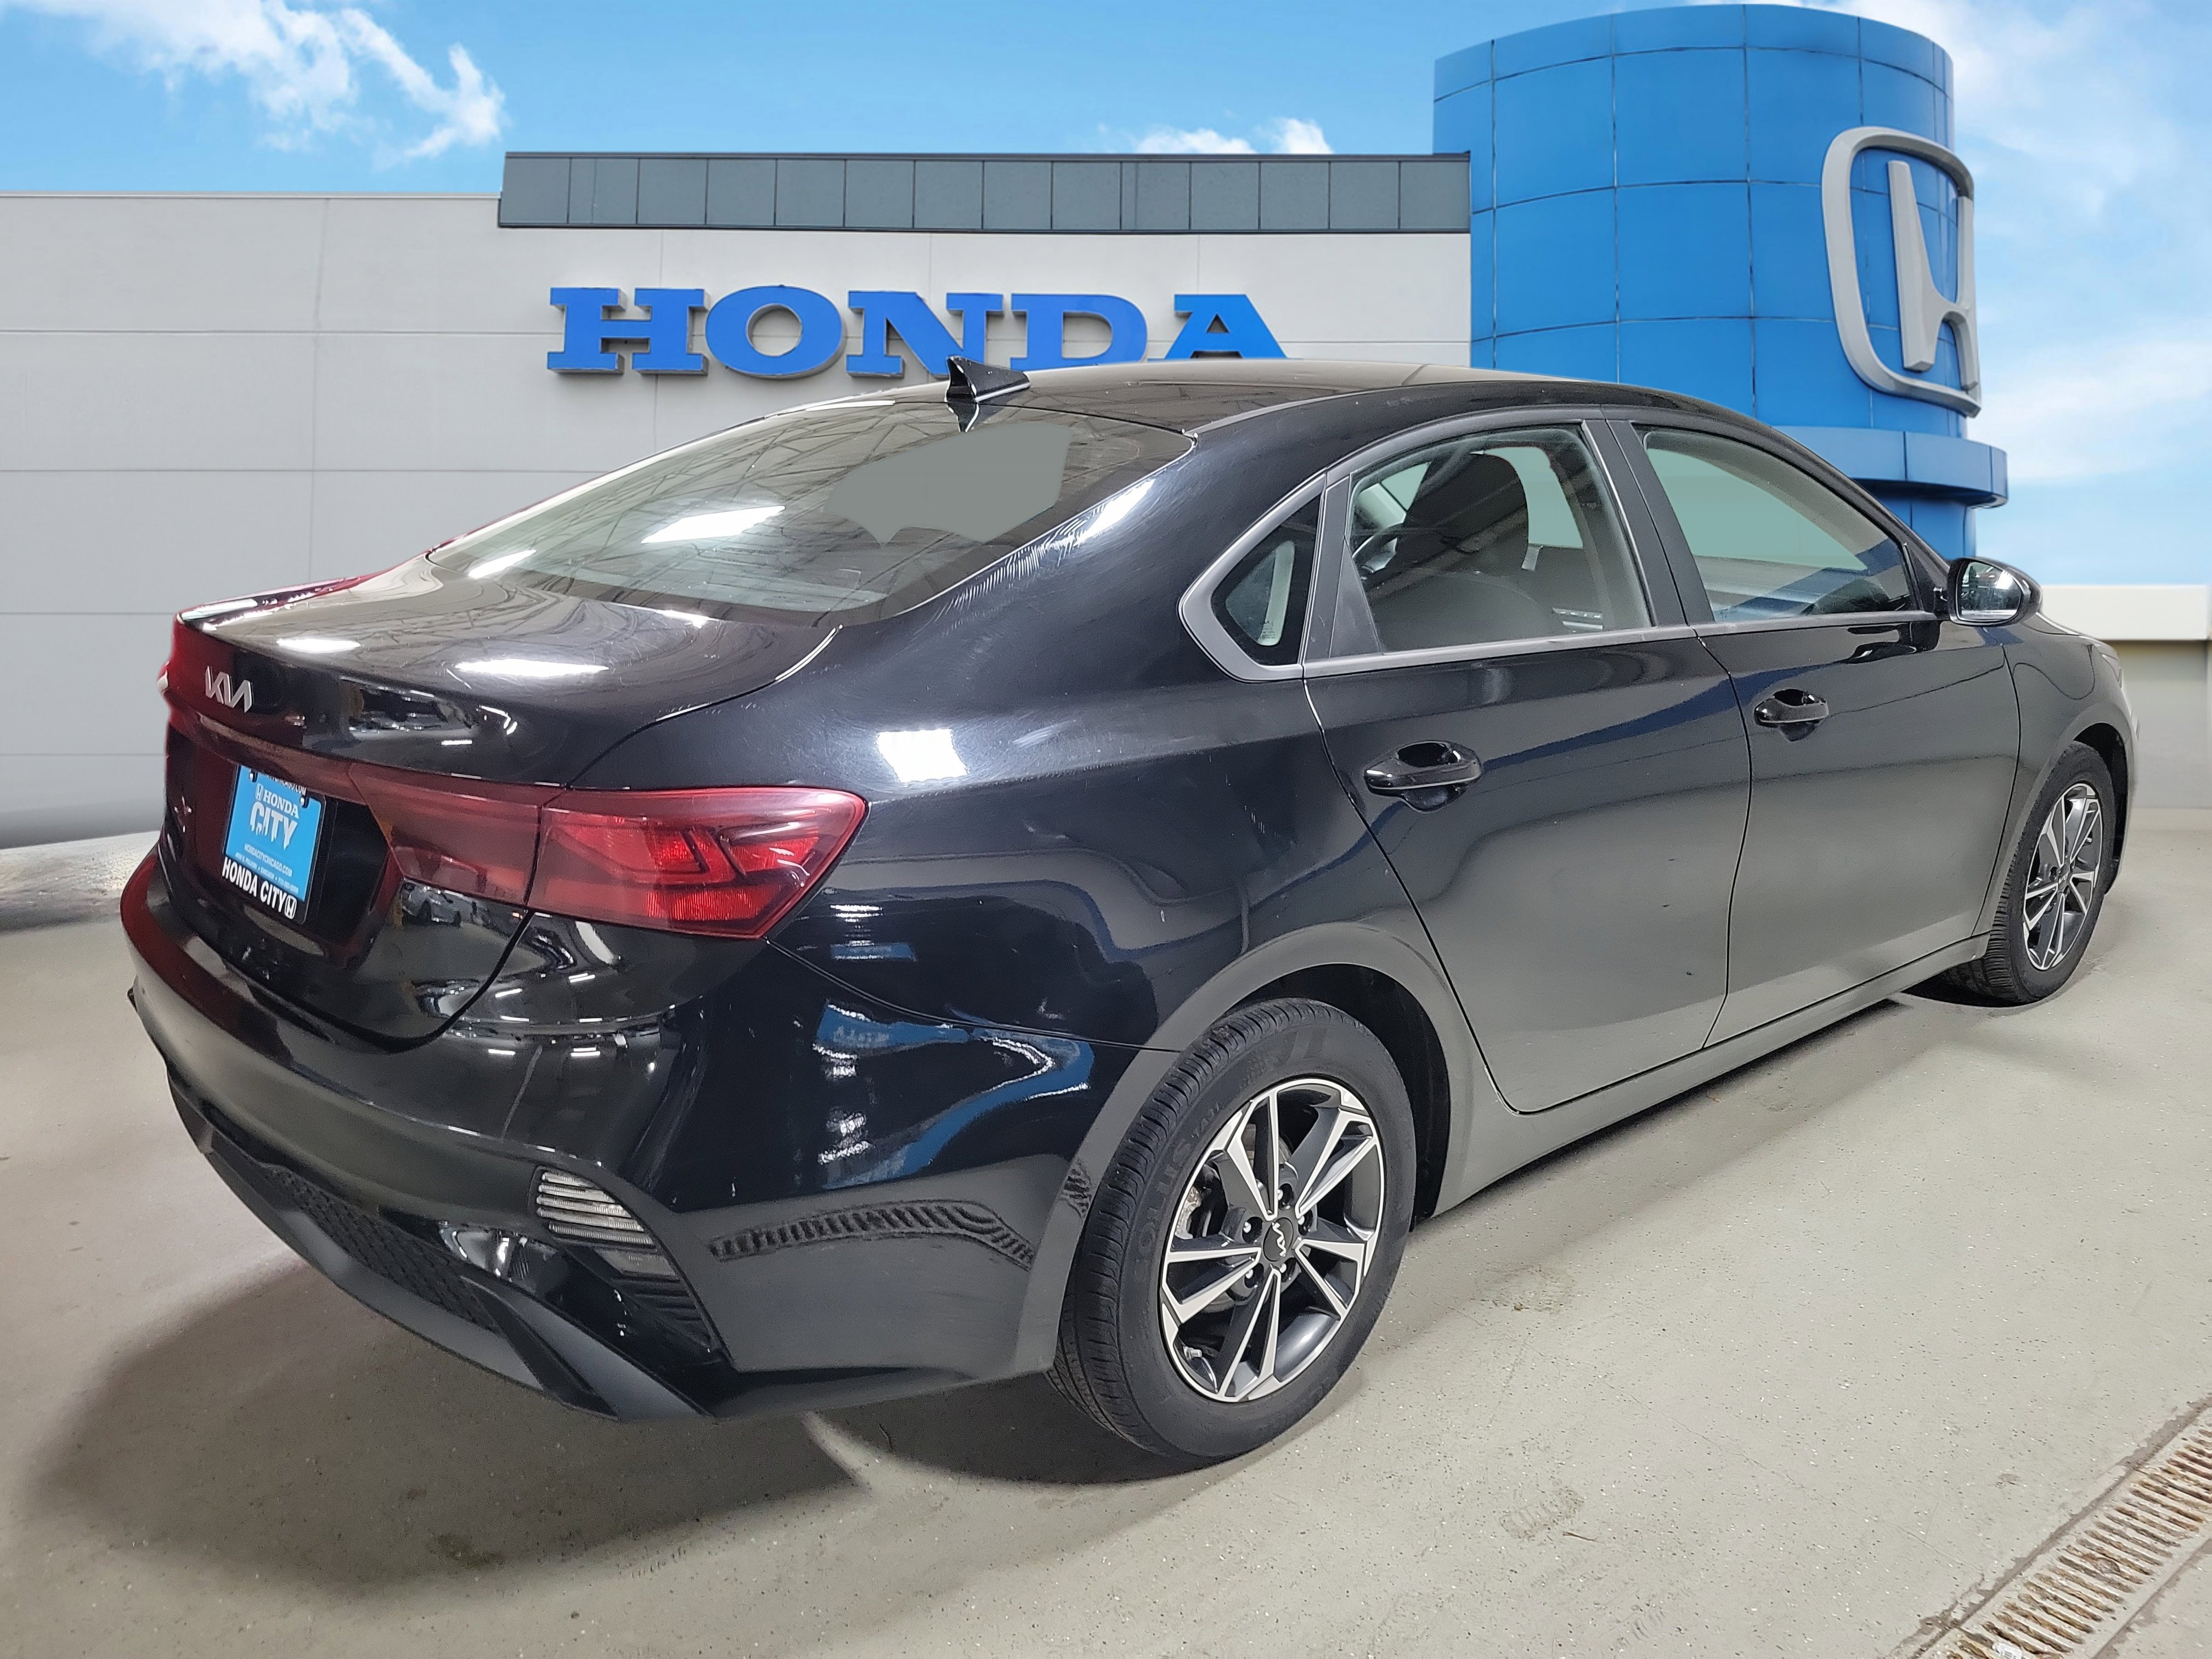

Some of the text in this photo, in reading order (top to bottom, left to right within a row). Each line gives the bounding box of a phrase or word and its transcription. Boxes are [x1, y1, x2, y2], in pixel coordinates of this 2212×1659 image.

[548, 285, 1302, 379] HONDA
[205, 665, 253, 713] KIA
[250, 801, 298, 850] CITY
[263, 789, 299, 820] HONDA
[222, 856, 258, 898] HONDA
[260, 880, 287, 913] CITY
